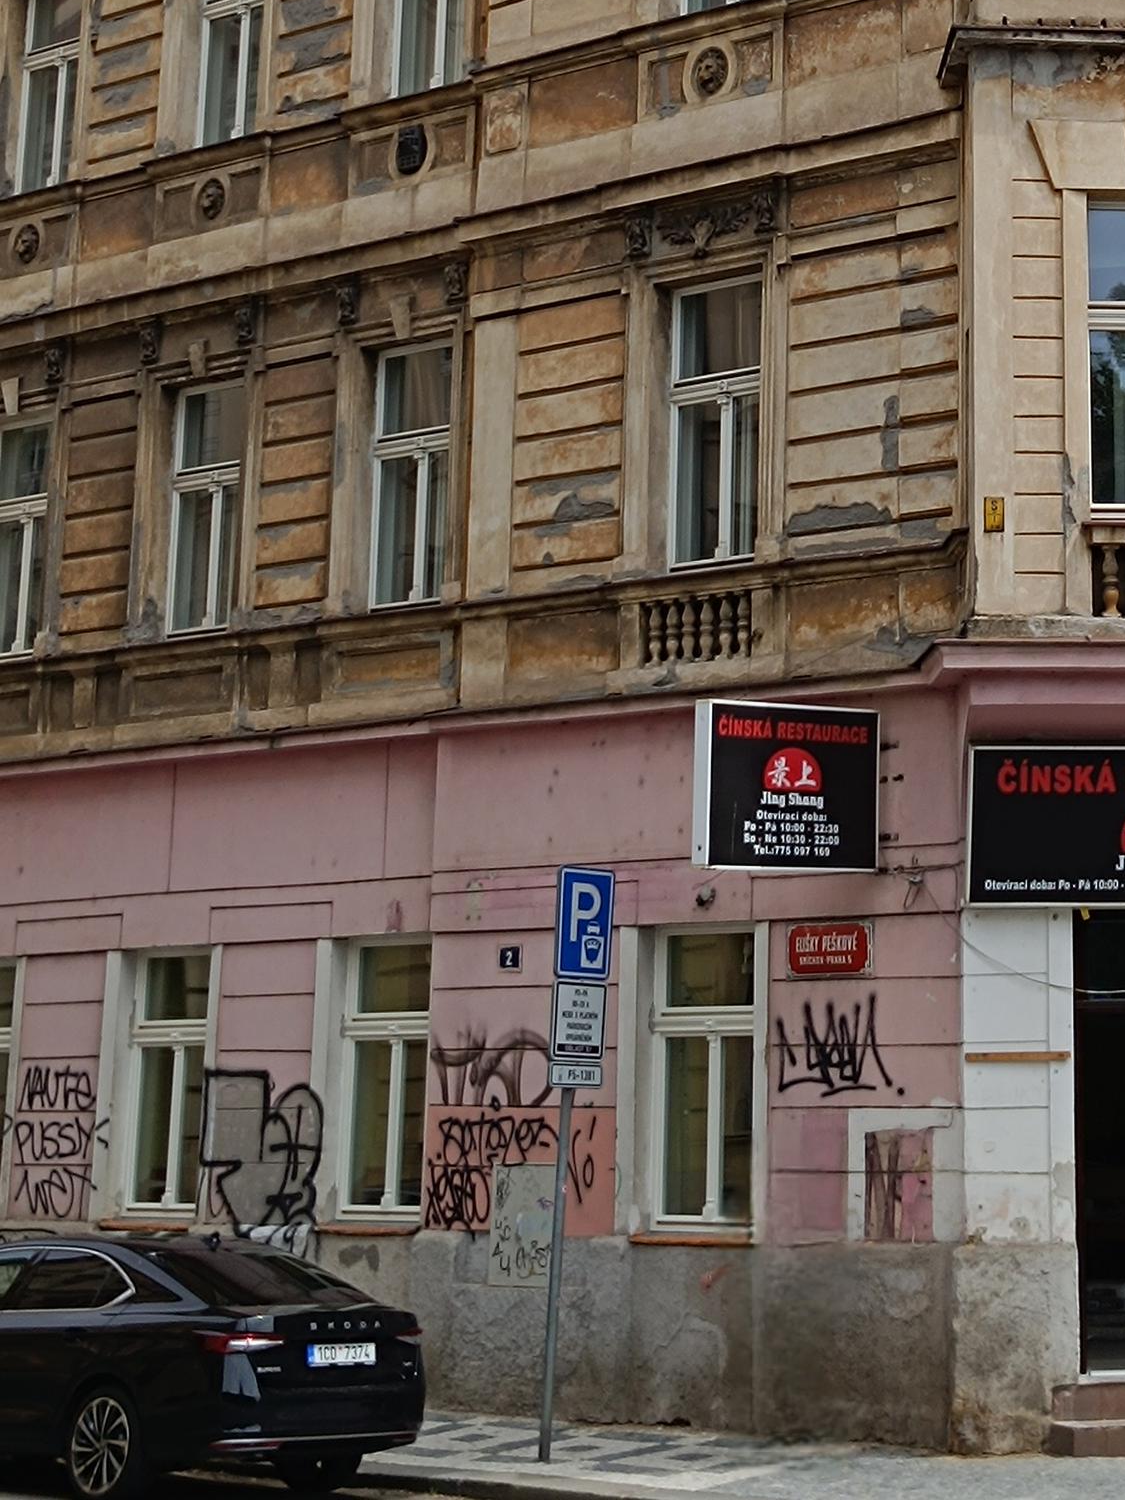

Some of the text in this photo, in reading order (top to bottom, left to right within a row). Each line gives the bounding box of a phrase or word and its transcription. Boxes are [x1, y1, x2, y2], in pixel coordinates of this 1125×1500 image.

[718, 714, 868, 744] ČÍNSKÁ RESTAURACE
[997, 758, 1117, 794] ČÍNSKÁ
[760, 791, 825, 810] Jing Shang
[743, 820, 756, 831] Po
[780, 822, 805, 833] 10:00
[814, 823, 839, 834] 22:30
[743, 832, 756, 843] So
[764, 833, 777, 843] Ne
[780, 834, 806, 844] 10:30
[814, 835, 840, 845] 22:00
[794, 845, 811, 856] 097
[814, 846, 830, 857] 169
[1058, 879, 1071, 890] Po
[1094, 879, 1119, 890] 10:00
[569, 881, 602, 943] P
[505, 950, 513, 966] 2
